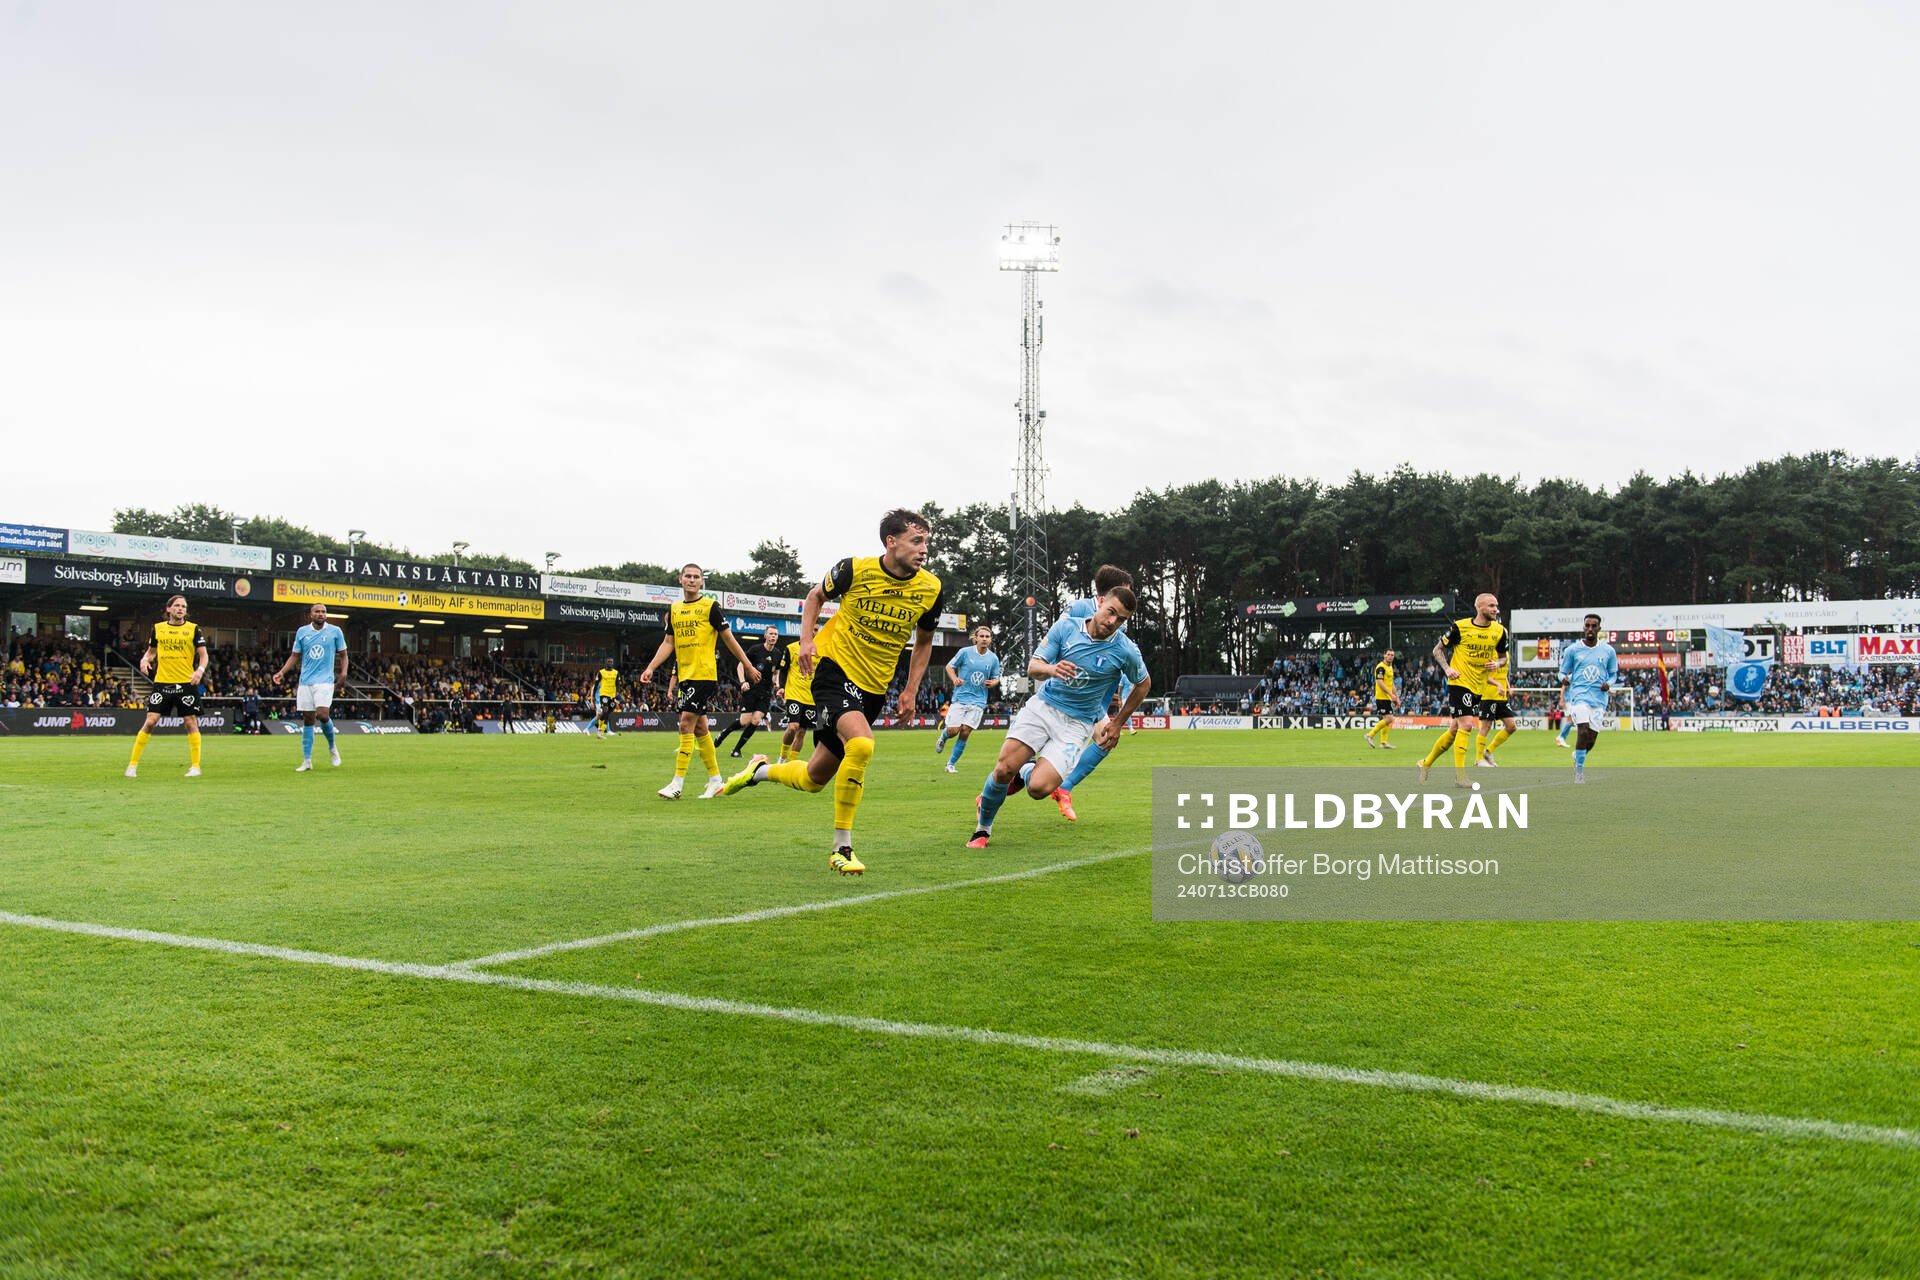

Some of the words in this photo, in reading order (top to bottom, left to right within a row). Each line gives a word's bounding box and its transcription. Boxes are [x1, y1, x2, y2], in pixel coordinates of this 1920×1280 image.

[54, 564, 170, 590] Sölvesborg-Mjällby
[173, 574, 226, 591] Sparbank
[275, 553, 539, 590] SPARBANKSLÄKTAREN
[548, 577, 587, 593] Lönneberga
[594, 581, 631, 597] Lönneberga
[289, 583, 350, 602] Sölvesborgs
[351, 587, 395, 603] kommun
[411, 594, 446, 609] Mjällby
[476, 598, 530, 615] hemmaplan
[855, 598, 917, 622] MELLBY
[560, 604, 626, 622] Sölvesborg-Mjällby
[628, 610, 660, 623] Sparbank
[673, 620, 700, 629] MELLBY
[858, 614, 902, 634] GÅRD
[677, 629, 696, 637] GÅRD
[1610, 632, 1617, 642] 2
[1628, 631, 1656, 641] 69:45
[1810, 641, 1847, 654] BLT
[843, 700, 849, 708] 5
[34, 716, 70, 728] JUMP
[85, 716, 116, 728] YARD
[615, 717, 635, 726] JUMP
[642, 717, 659, 726] YARD
[1288, 715, 1380, 730] XL-BYGG
[1516, 718, 1542, 728] eber
[1790, 720, 1909, 731] AHLBERG
